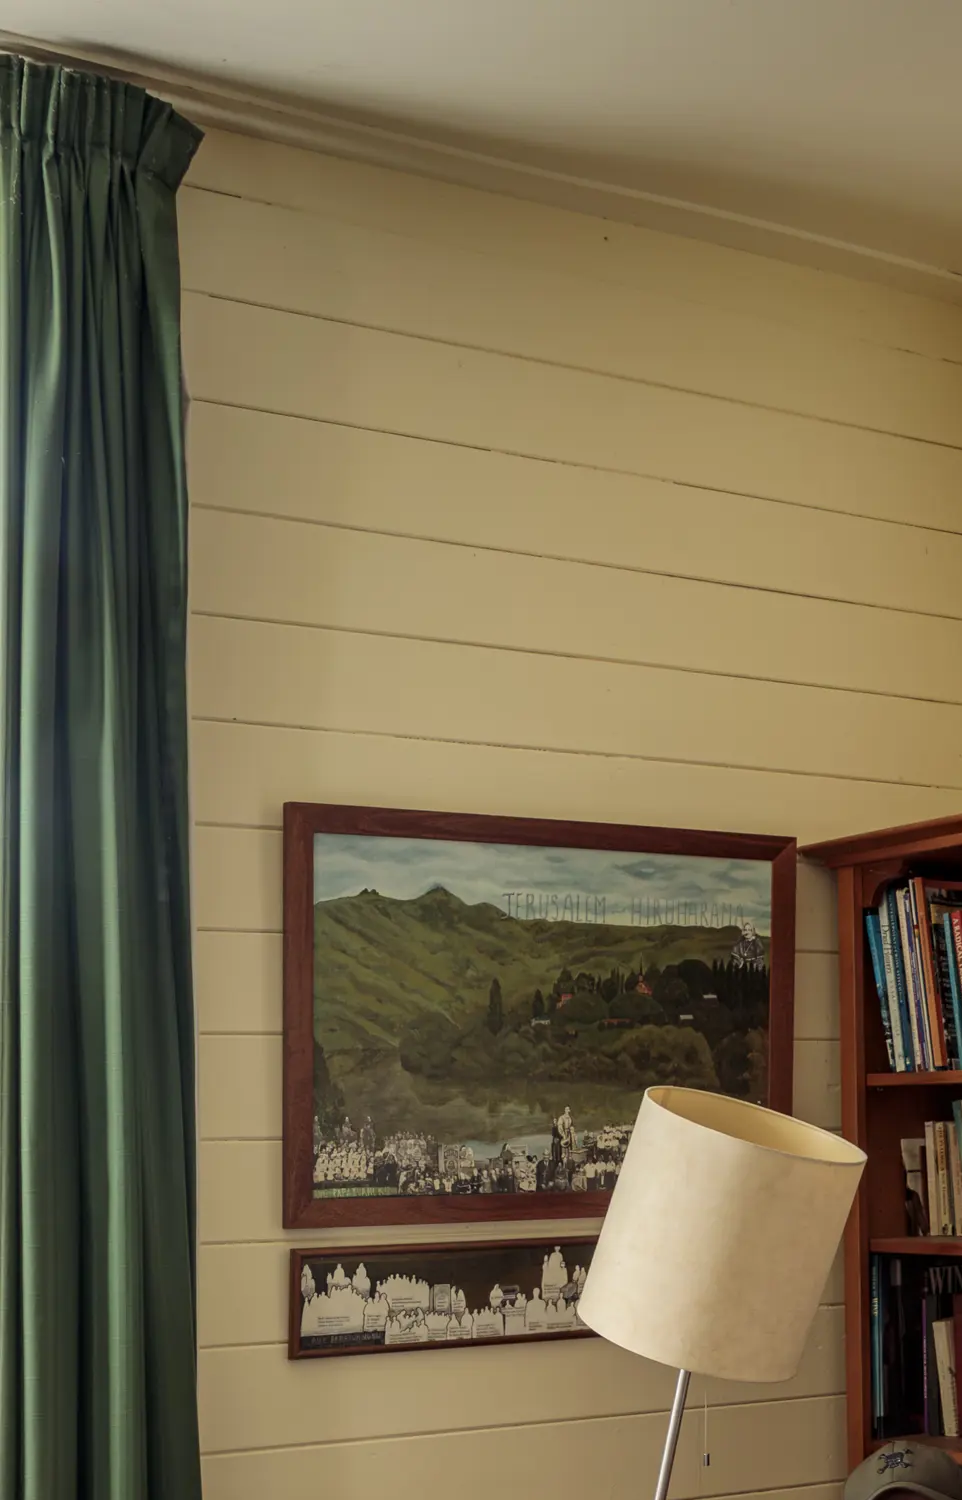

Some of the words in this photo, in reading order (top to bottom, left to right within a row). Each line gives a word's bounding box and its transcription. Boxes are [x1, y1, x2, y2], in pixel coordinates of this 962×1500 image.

[502, 893, 607, 924] JERUSALEM
[630, 896, 747, 927] HIRUHARAMA
[952, 925, 962, 961] RADICAL
